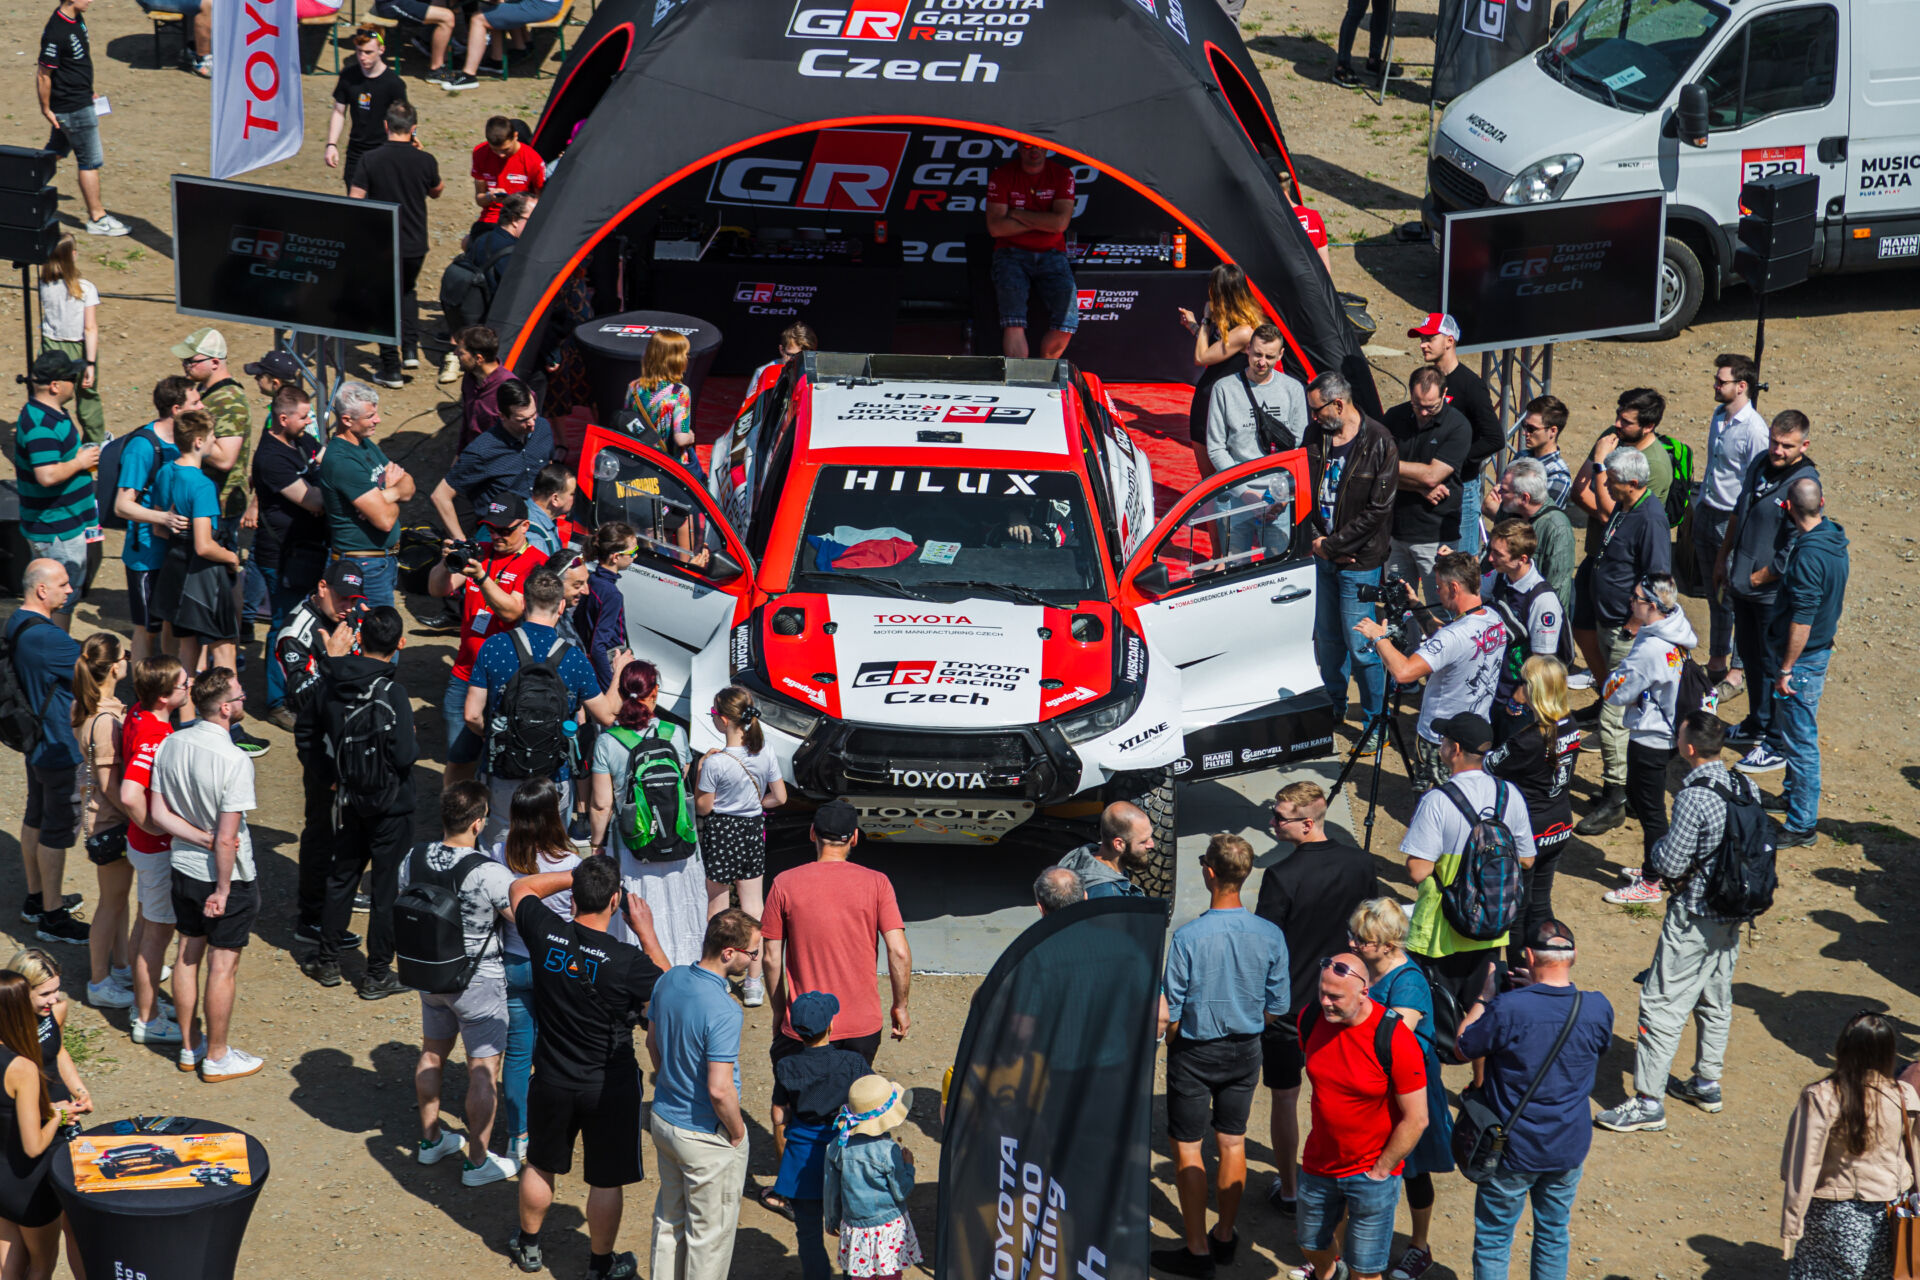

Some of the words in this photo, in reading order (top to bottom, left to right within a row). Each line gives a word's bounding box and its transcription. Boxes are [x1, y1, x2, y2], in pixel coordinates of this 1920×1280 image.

[924, 0, 1044, 10] TOYOTA
[793, 9, 901, 38] GR
[913, 11, 1030, 26] GAZOO
[908, 26, 1024, 47] Racing
[243, 0, 281, 140] TOY
[798, 48, 1000, 83] Czech
[1466, 113, 1508, 144] MUSICDATA
[1861, 155, 1920, 173] MUSIC
[718, 157, 890, 208] GR
[1860, 173, 1912, 190] DATA
[231, 237, 280, 258] GR
[287, 233, 346, 249] TOYOTA
[1556, 240, 1613, 253] TOYOTA
[1883, 237, 1919, 249] MANN
[285, 243, 339, 258] GAZOO
[1553, 250, 1606, 264] GAZOO
[1881, 245, 1919, 257] FILTER
[249, 263, 319, 284] Czech
[1500, 258, 1548, 277] GR
[775, 290, 813, 298] GAZOO
[777, 284, 818, 292] TOYOTA
[1516, 278, 1584, 296] Czech
[736, 290, 771, 302] GR
[749, 305, 798, 316] Czech
[1095, 302, 1132, 310] Racing
[853, 401, 942, 410] Racing
[884, 392, 1000, 404] Czech
[837, 413, 936, 423] TOYOTA
[848, 408, 939, 417] GAZOO
[950, 406, 1035, 418] GR
[843, 470, 1040, 496] HILUX
[873, 615, 973, 624] TOYOTA
[736, 625, 749, 671] MUSICDATA
[1126, 637, 1140, 682] MUSICDATA
[939, 669, 1021, 681] GAZOO
[943, 661, 1030, 674] TOYOTA
[855, 669, 932, 687] GR
[937, 676, 1017, 691] Racing
[884, 691, 990, 706] Czech
[1118, 721, 1171, 753] XTLINE
[1290, 743, 1310, 752] PNEU
[1310, 736, 1333, 747] KAFKA
[1204, 752, 1232, 763] MANN
[1204, 758, 1232, 769] FILTER
[1174, 760, 1190, 771] ELL
[889, 769, 986, 790] TOYOTA
[856, 806, 1016, 821] TOYOTA
[861, 822, 914, 830] over
[944, 822, 1006, 832] drive
[1538, 828, 1572, 847] HILUX
[990, 1136, 1018, 1280] OYOTA
[1039, 1176, 1066, 1280] cing
